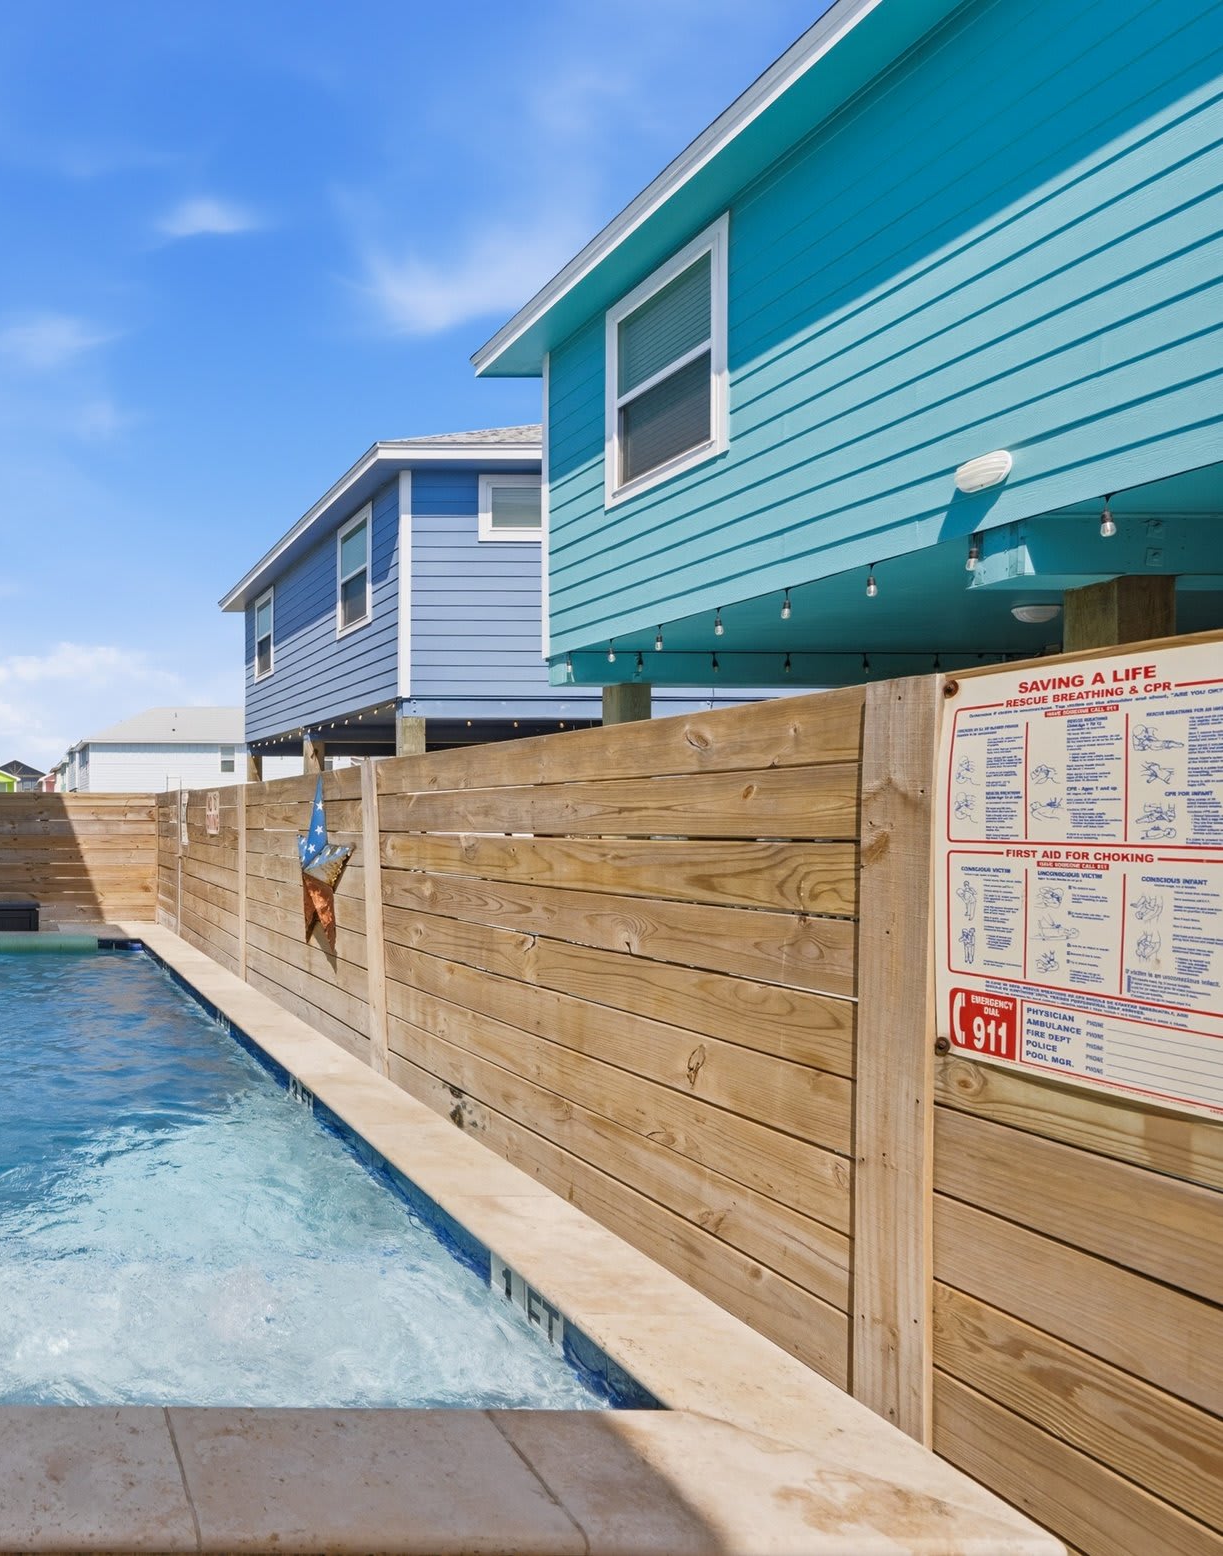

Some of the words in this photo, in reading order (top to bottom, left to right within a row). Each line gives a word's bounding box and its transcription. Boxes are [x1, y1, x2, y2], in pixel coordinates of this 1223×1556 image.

[1018, 674, 1084, 694] SAVING
[1091, 672, 1106, 686] A
[1112, 665, 1156, 683] LIFE
[1005, 696, 1048, 708] RESCUE
[1052, 686, 1124, 703] BREATHING
[1129, 685, 1138, 695] &
[1143, 682, 1172, 694] CPR
[1006, 849, 1038, 859] FIRST
[1042, 850, 1062, 860] AID
[1066, 851, 1090, 860] FOR
[1093, 852, 1154, 863] CHOKING
[1141, 876, 1181, 884] CONSCIOUS
[1182, 878, 1208, 886] INFANT
[970, 994, 1014, 1010] EMERGENCY
[983, 1008, 1000, 1018] DIAL
[1026, 1007, 1075, 1023] PHYSICIAN
[972, 1016, 1007, 1055] 911
[1026, 1018, 1082, 1036] AMBULANCE
[1026, 1028, 1046, 1040] FIRE
[1048, 1034, 1072, 1045] DEPT
[1026, 1040, 1058, 1053] POLICE
[1026, 1050, 1049, 1062] POOL
[1051, 1056, 1075, 1068] MGR.
[527, 1286, 560, 1344] FT
